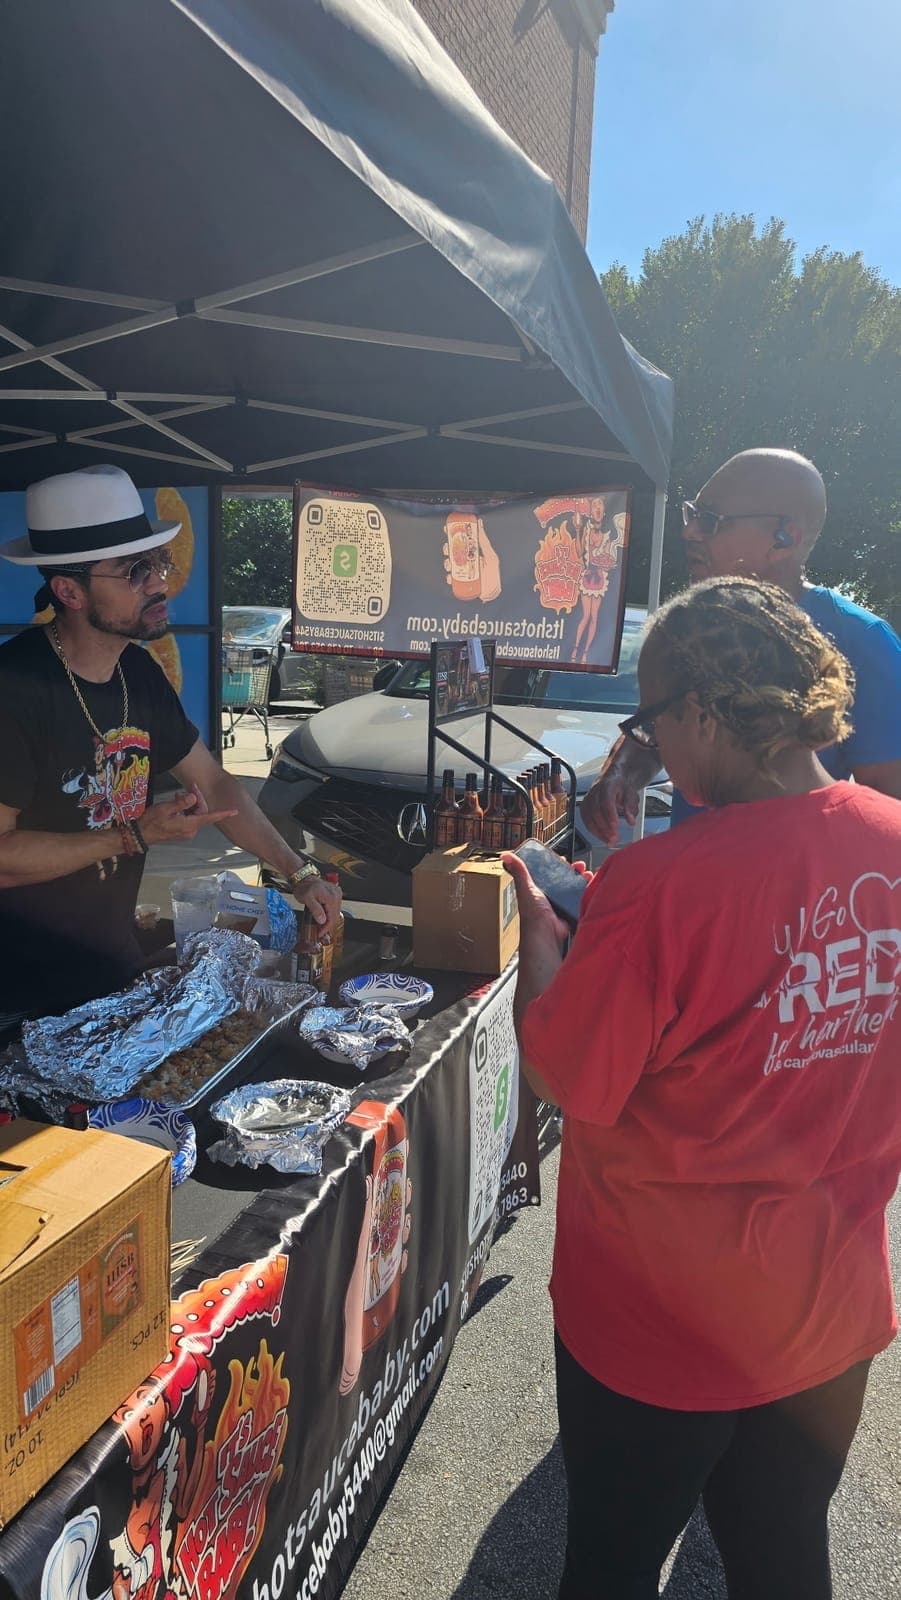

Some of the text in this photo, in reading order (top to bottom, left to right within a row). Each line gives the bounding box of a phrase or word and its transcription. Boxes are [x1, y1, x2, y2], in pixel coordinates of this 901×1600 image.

[778, 929, 901, 1024] RED
[153, 1310, 167, 1331] 12
[28, 1429, 44, 1455] 10
[177, 1487, 223, 1597] HOT
